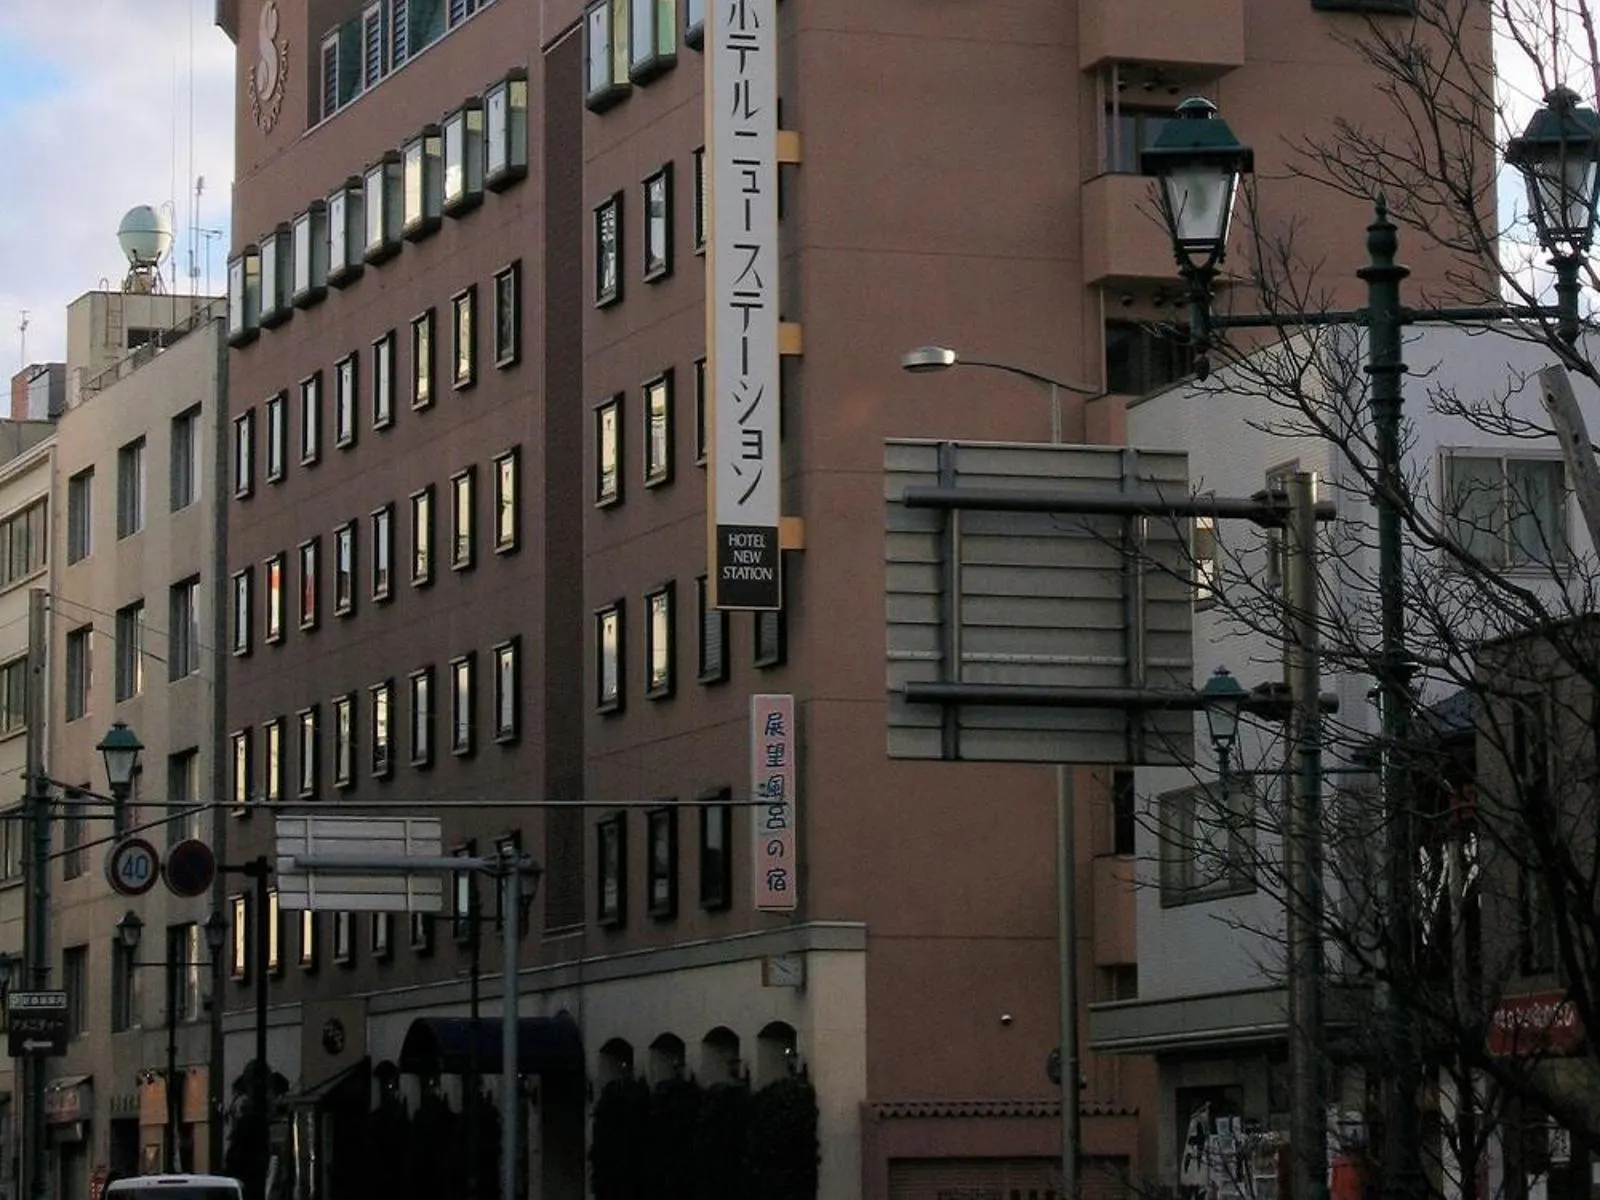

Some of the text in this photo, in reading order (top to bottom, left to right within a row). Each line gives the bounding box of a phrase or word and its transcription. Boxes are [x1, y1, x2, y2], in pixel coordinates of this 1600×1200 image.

[729, 533, 766, 548] HOTEL
[733, 550, 762, 564] NEW
[723, 566, 772, 580] STATION
[122, 855, 149, 879] 40
